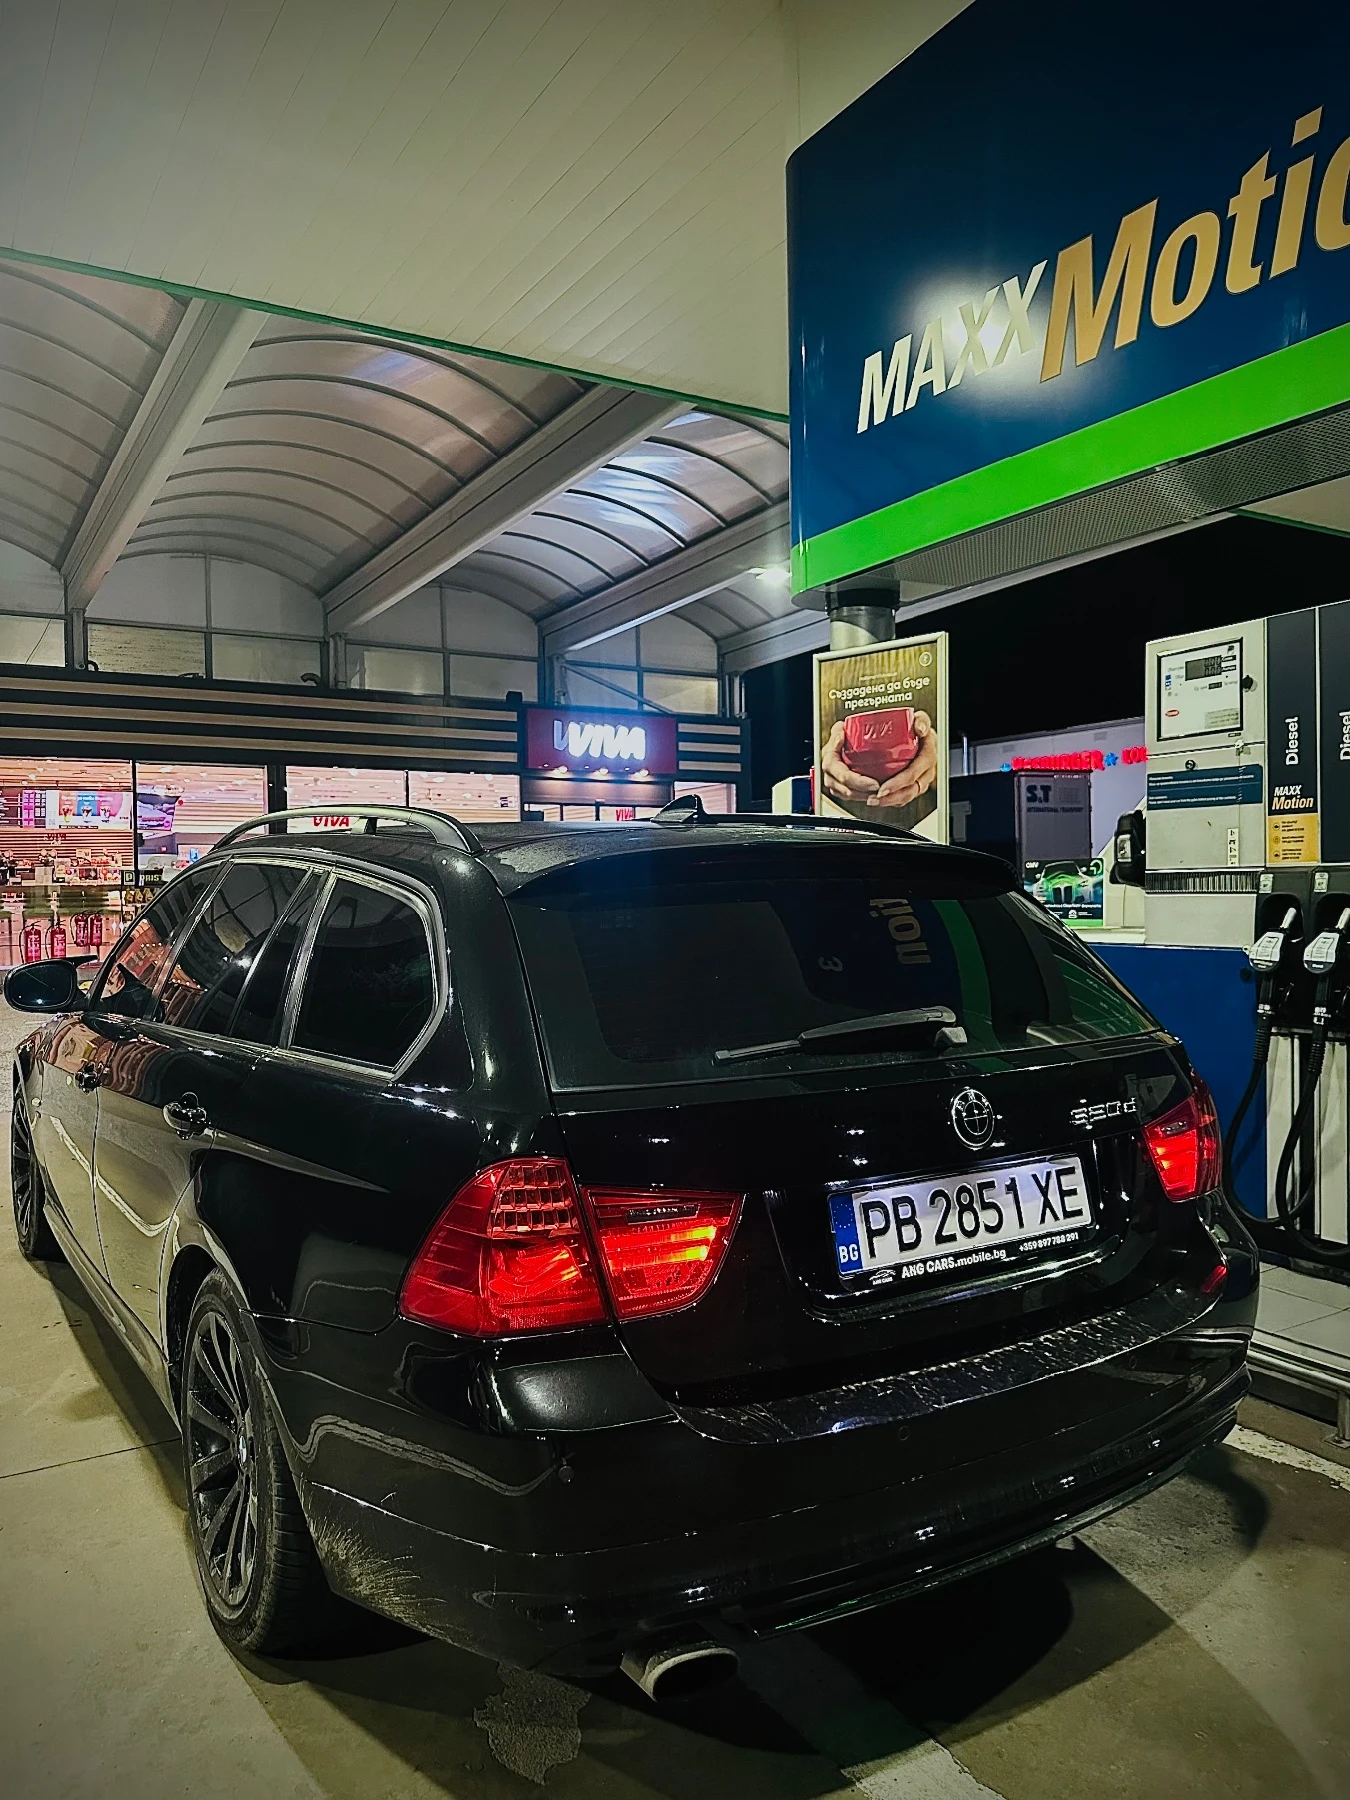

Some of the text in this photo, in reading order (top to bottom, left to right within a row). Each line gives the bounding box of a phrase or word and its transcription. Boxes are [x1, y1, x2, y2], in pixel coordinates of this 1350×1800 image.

[856, 259, 1048, 434] MAXX
[828, 684, 886, 701] Създадена
[886, 681, 901, 694] да
[902, 676, 931, 690] бъде
[844, 691, 913, 711] прегърната
[1285, 716, 1299, 766] Diesel
[1338, 711, 1350, 761] Diesel
[1271, 795, 1314, 811] Motion
[1273, 785, 1302, 797] MAXX
[313, 816, 350, 827] VIVA
[615, 808, 633, 821] VIVA
[1070, 1097, 1137, 1126] 320d
[859, 1166, 1084, 1259] PB 2851 XE
[838, 1244, 859, 1264] BG
[901, 1249, 1007, 1279] ANG CARS.mobile.bg
